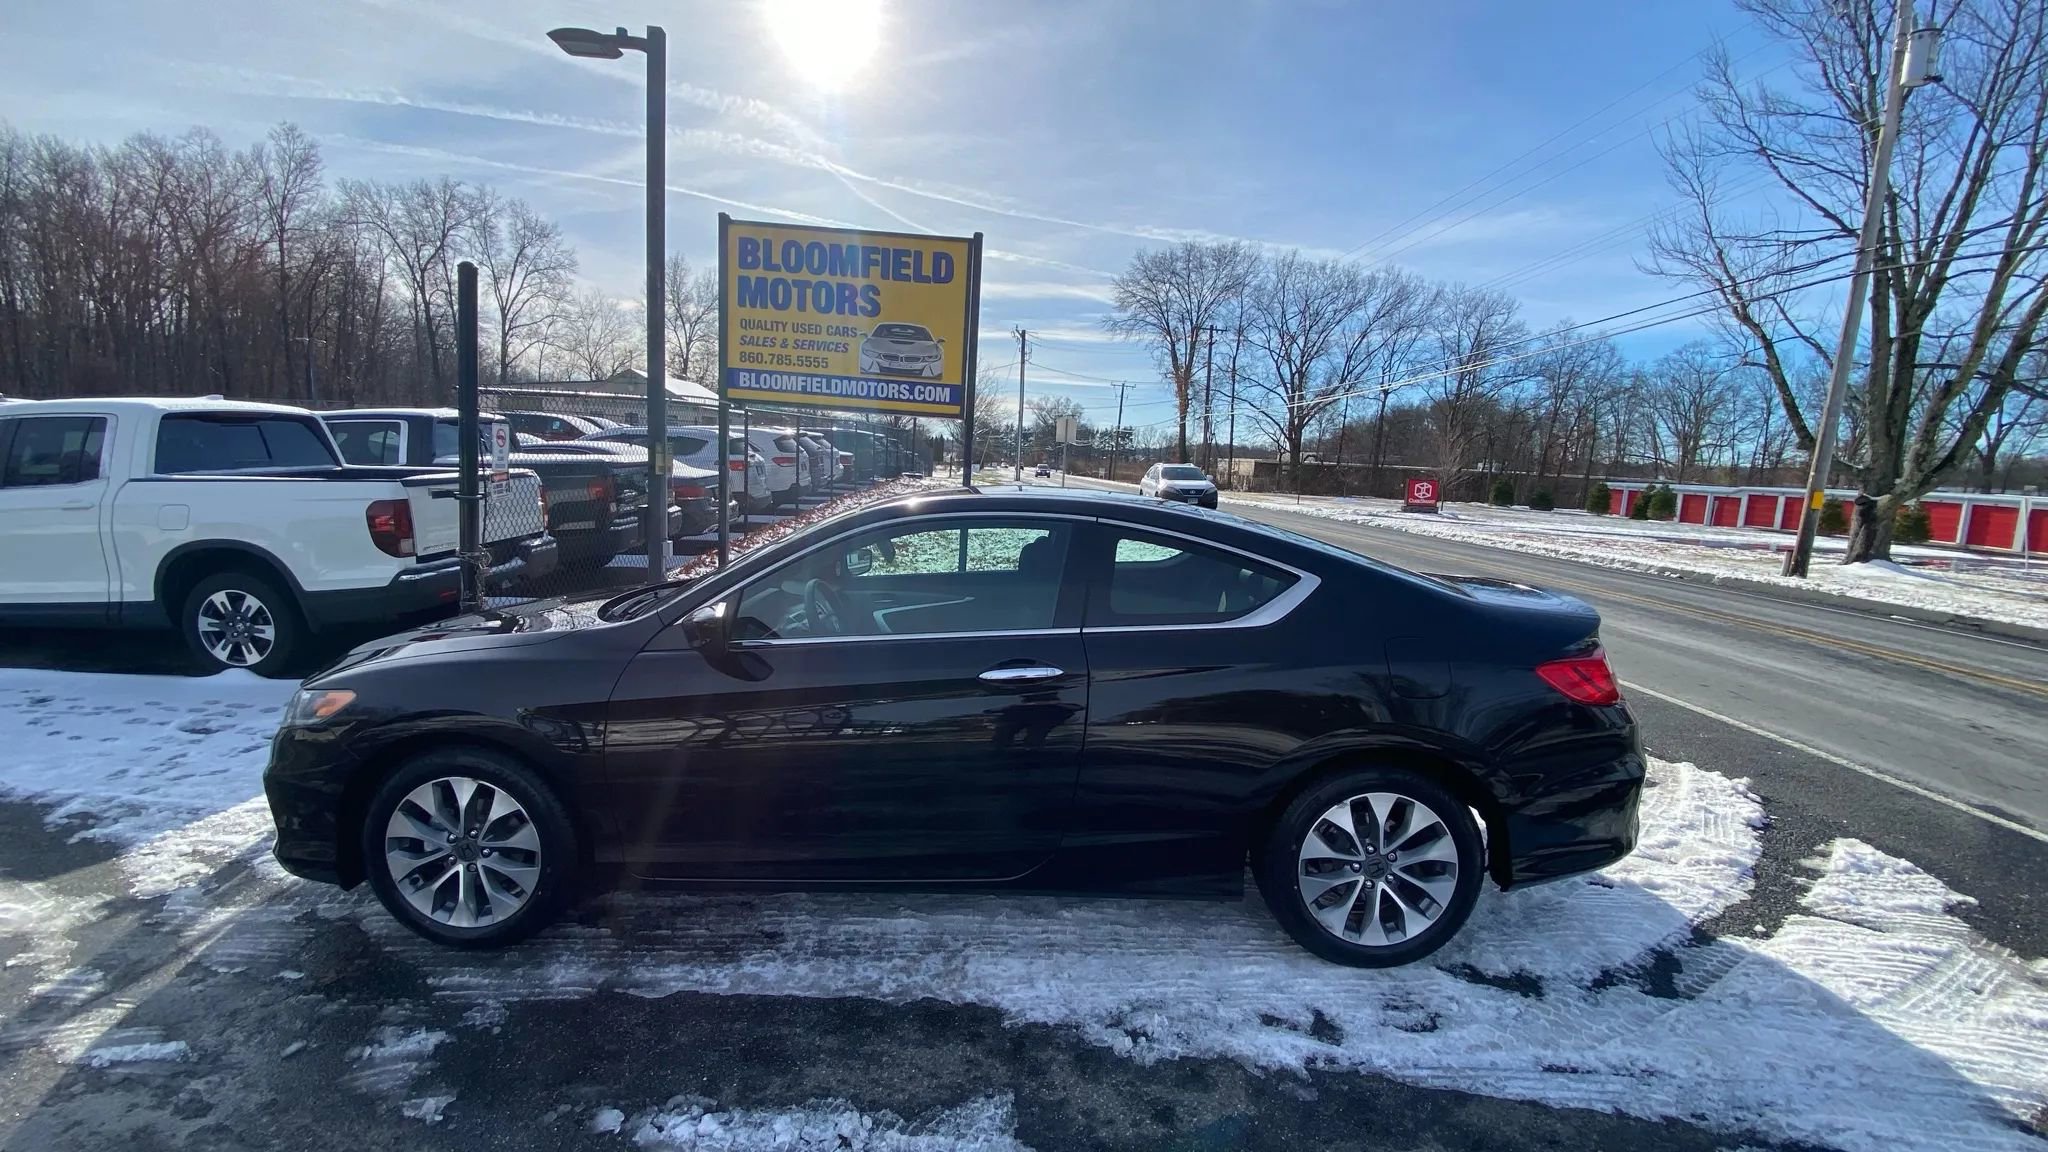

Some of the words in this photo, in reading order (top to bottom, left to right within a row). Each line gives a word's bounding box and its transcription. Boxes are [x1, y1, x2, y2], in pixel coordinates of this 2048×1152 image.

[737, 236, 955, 284] BLOOMFIELD
[737, 275, 882, 318] MOTORS
[740, 318, 788, 333] QUALITY
[792, 322, 822, 335] USED
[826, 325, 858, 338] CARS
[739, 334, 777, 348] SALES
[780, 338, 789, 349] &
[792, 339, 850, 353] SERVICES
[739, 351, 829, 369] 860.785.5555
[739, 371, 951, 403] BLOOMFIELDMOTORS.COM
